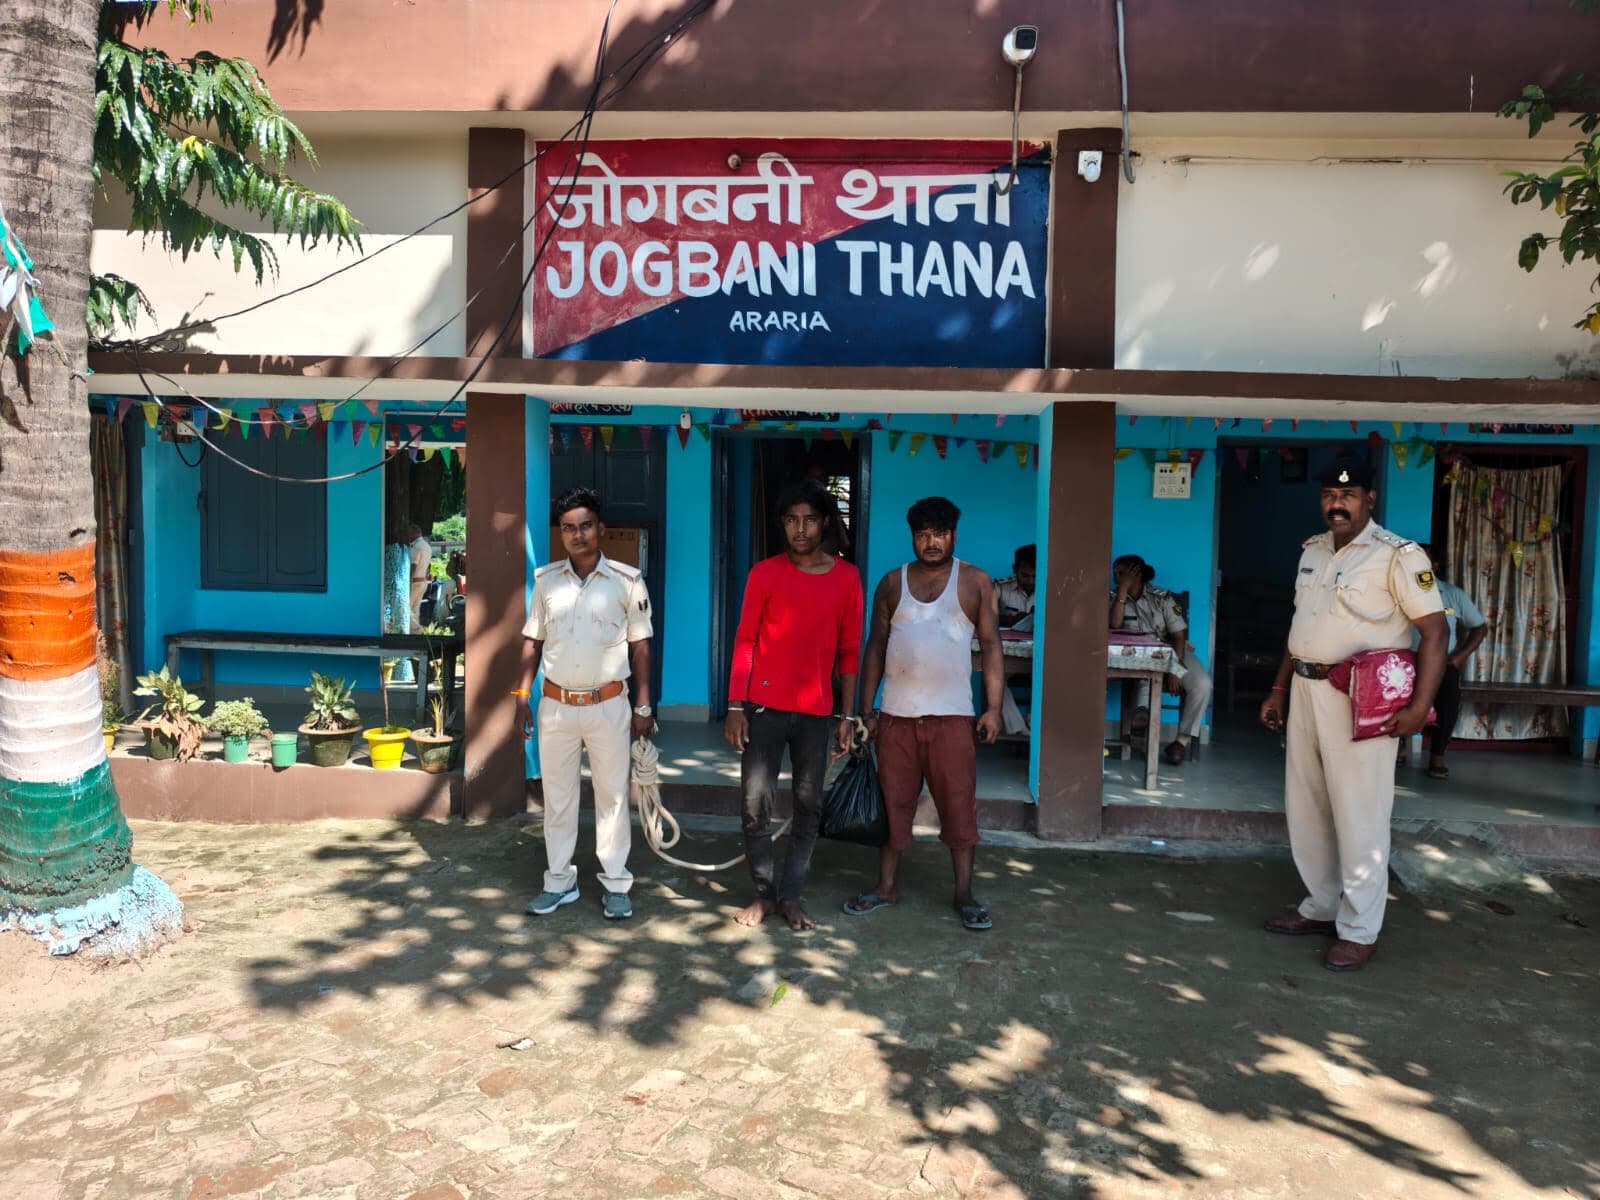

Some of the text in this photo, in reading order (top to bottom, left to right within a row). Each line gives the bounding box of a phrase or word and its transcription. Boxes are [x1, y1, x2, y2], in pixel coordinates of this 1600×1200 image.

[546, 152, 1019, 229] जोगबनी थाना
[546, 240, 1036, 299] JOGBANI THANA
[729, 310, 831, 332] ARARIA
